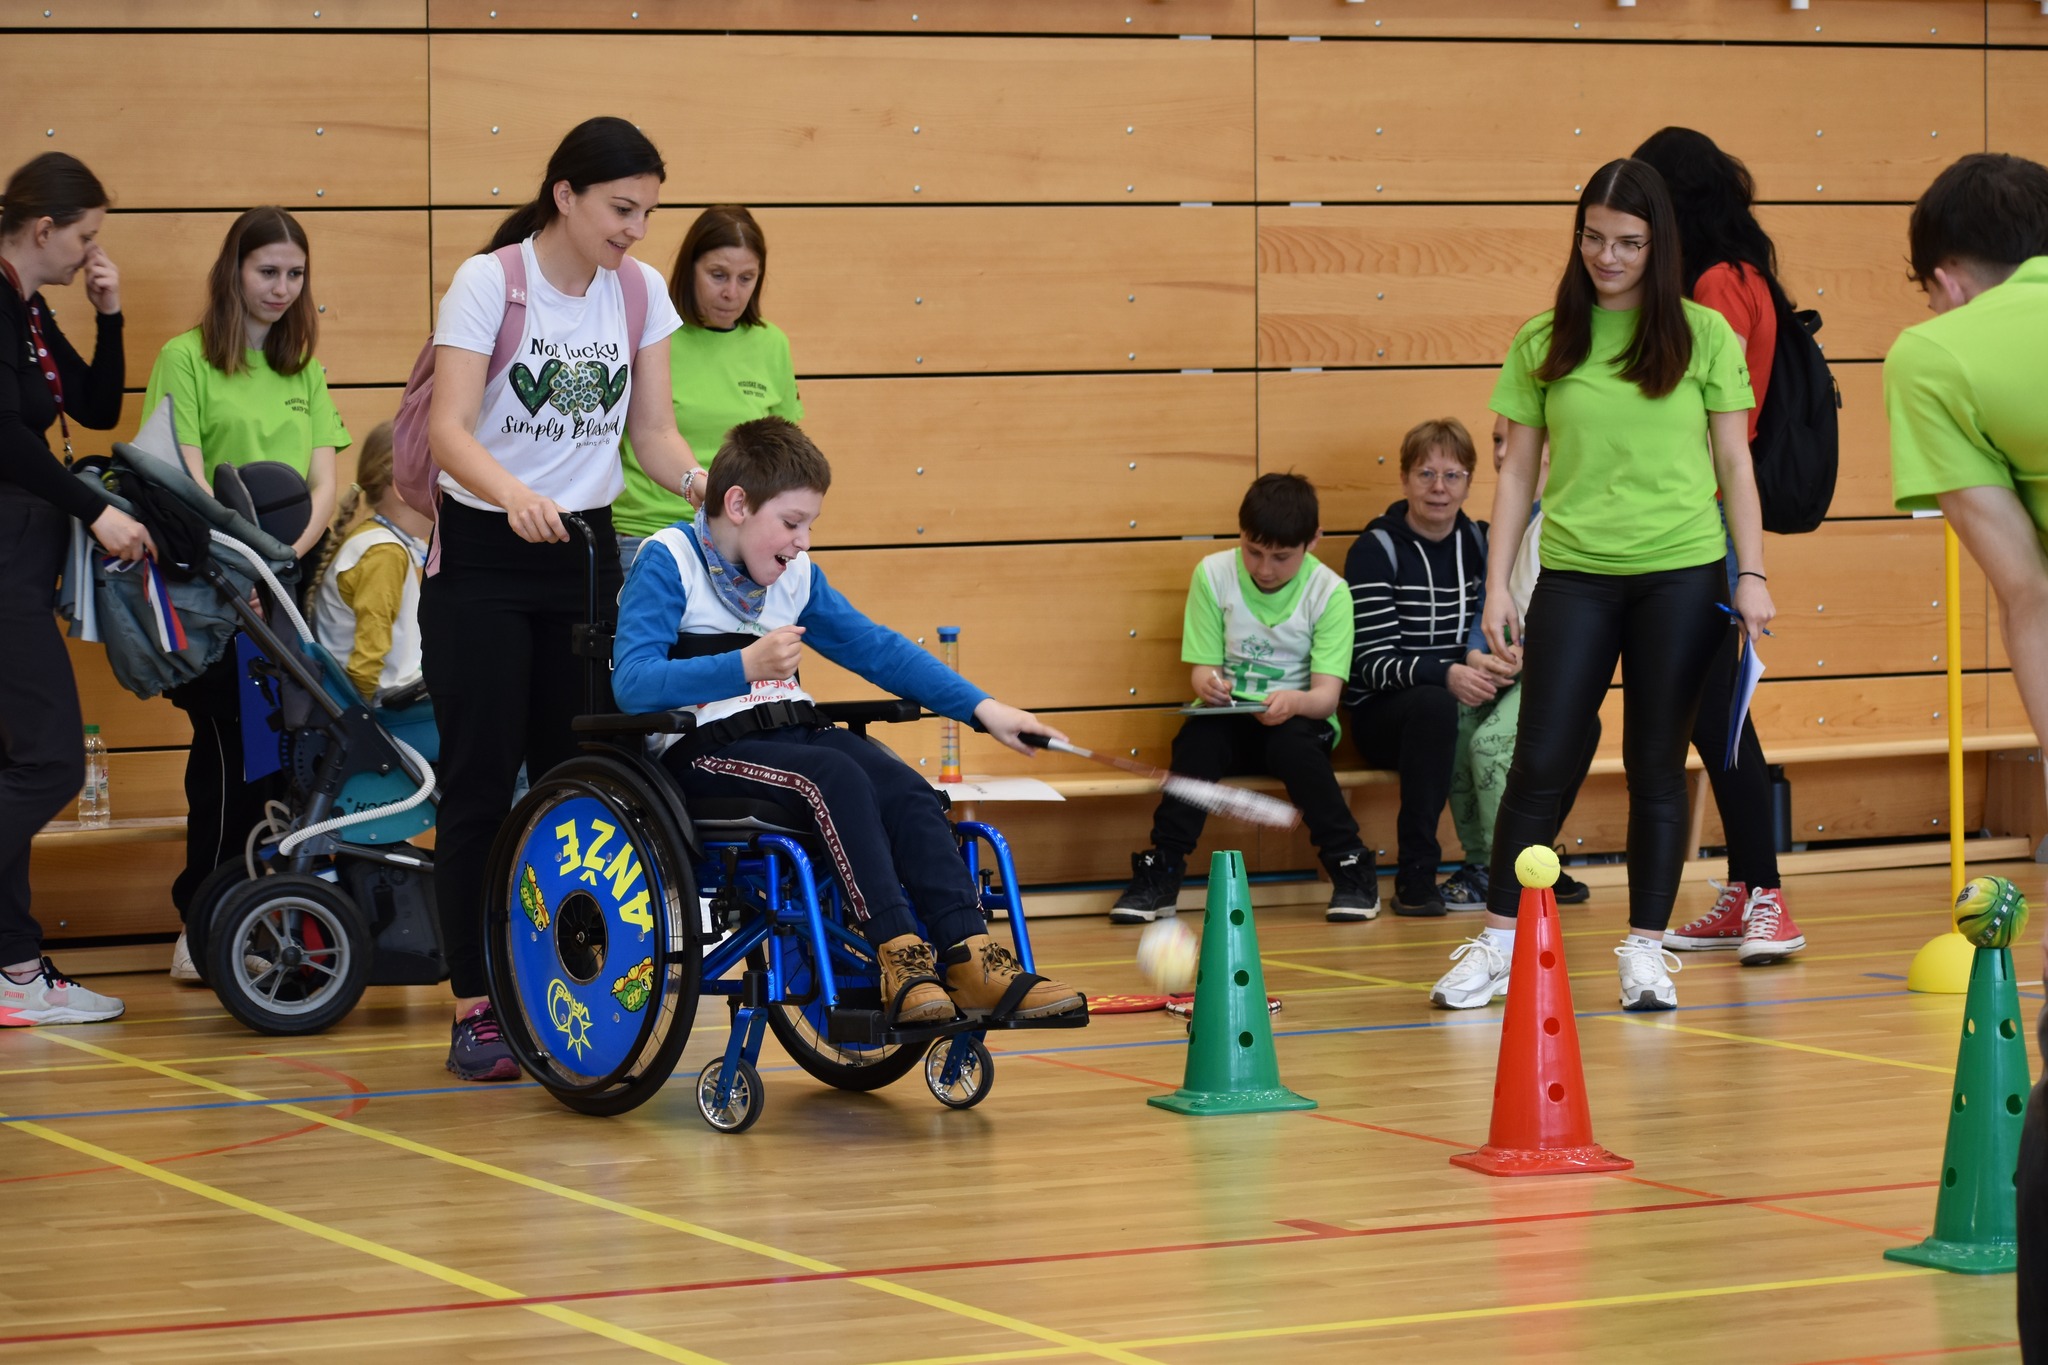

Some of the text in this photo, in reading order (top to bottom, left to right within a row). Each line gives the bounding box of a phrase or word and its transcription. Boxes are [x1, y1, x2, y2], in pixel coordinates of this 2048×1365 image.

[530, 338, 619, 361] Not lucky
[501, 415, 566, 442] Simply
[555, 818, 655, 933] ANŽE
[4, 990, 25, 1000] PUMA
